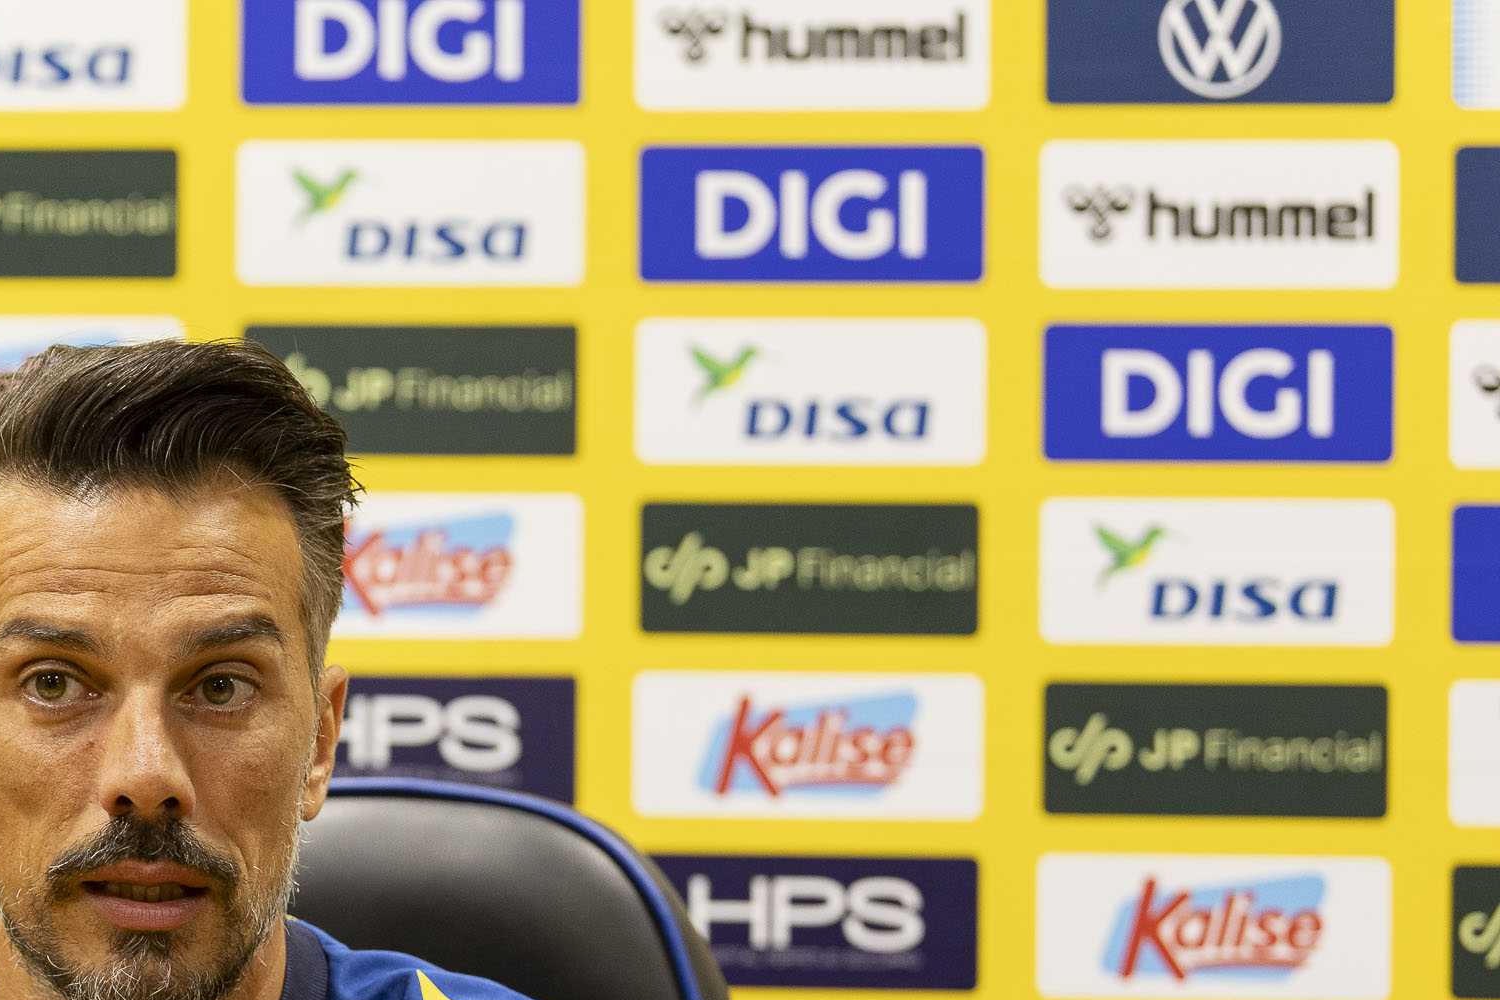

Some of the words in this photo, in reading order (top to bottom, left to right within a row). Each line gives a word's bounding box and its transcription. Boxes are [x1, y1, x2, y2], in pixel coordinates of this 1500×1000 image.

[294, 0, 525, 82] DIGI
[738, 14, 966, 62] hummel
[694, 169, 928, 260] DIGI
[1146, 188, 1377, 240] hummel
[1101, 347, 1335, 440] DIGI
[732, 546, 796, 591] JP
[717, 695, 916, 799] Kalise
[1138, 726, 1200, 772] JP
[1203, 727, 1383, 774] Financial
[687, 874, 925, 954] HPS
[1117, 875, 1324, 983] Kalise
